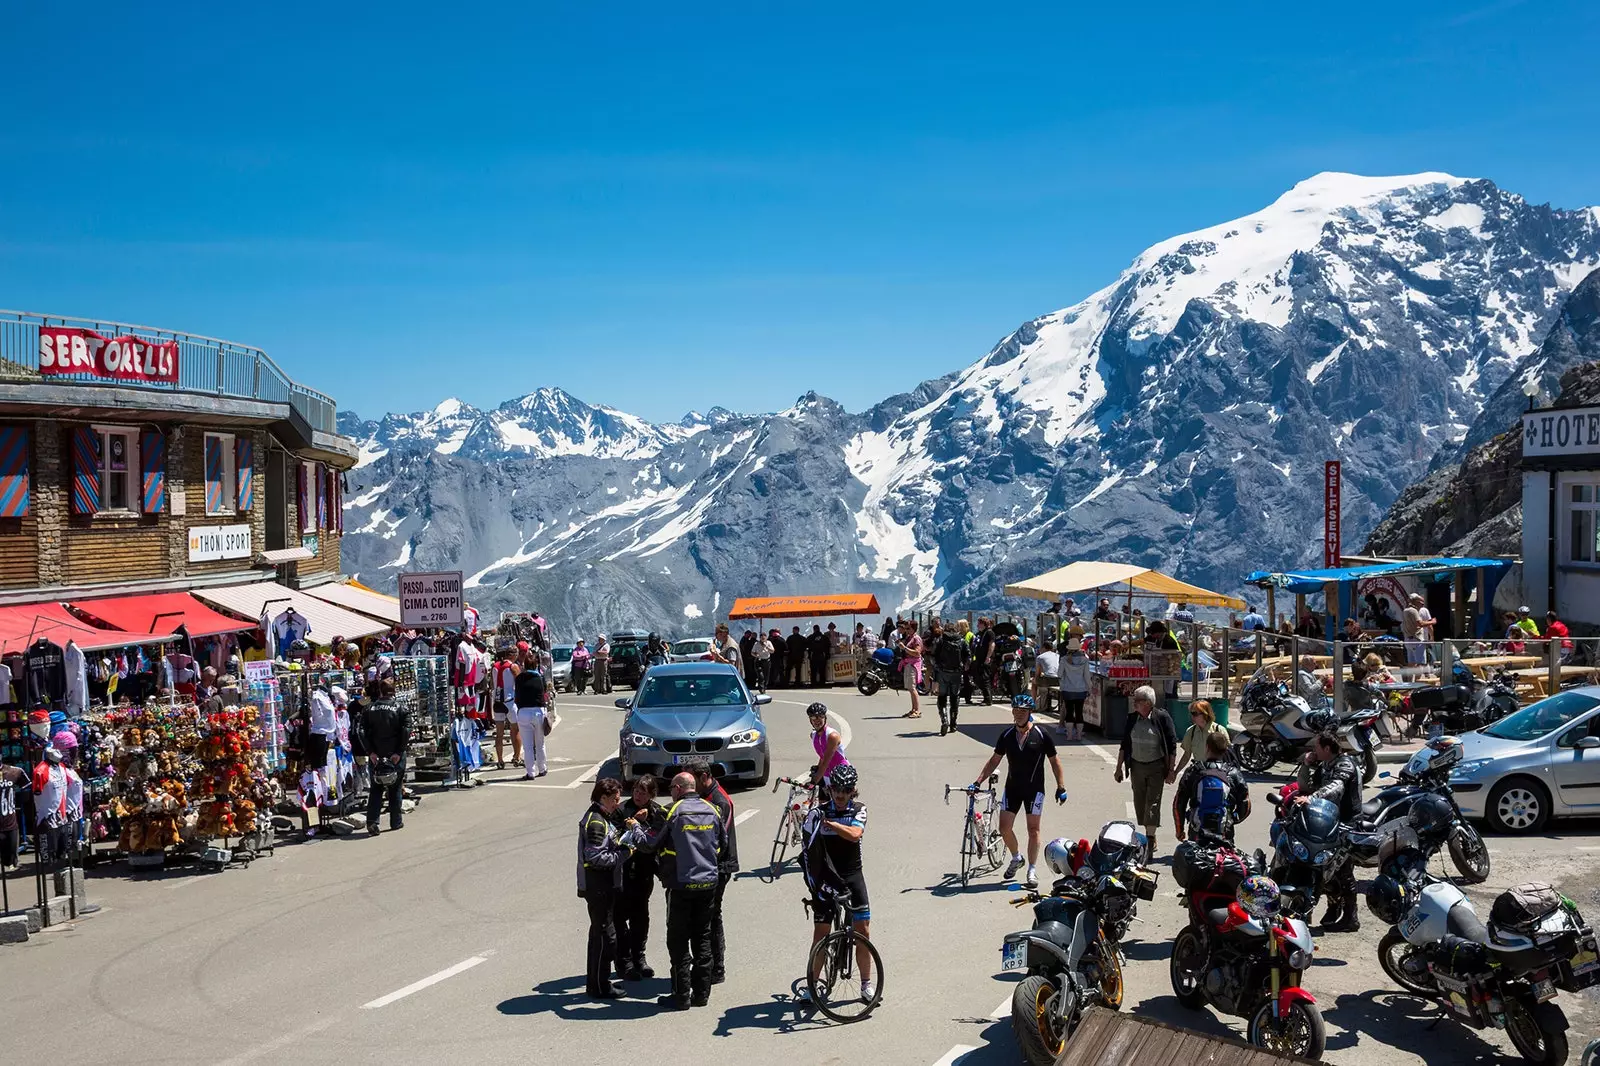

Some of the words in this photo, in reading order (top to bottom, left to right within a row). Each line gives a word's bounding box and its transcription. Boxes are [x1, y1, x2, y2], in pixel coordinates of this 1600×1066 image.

[40, 335, 173, 376] SERTORELLI
[1540, 413, 1600, 448] HOTE
[200, 531, 223, 552] THÖNI
[226, 532, 250, 551] SPORT
[404, 581, 424, 594] PASSO
[433, 579, 459, 593] STELVIO
[404, 598, 428, 610] CIMA
[431, 597, 459, 609] COPPI
[431, 613, 448, 621] 2760
[834, 660, 853, 671] Grill
[1005, 961, 1016, 969] KP
